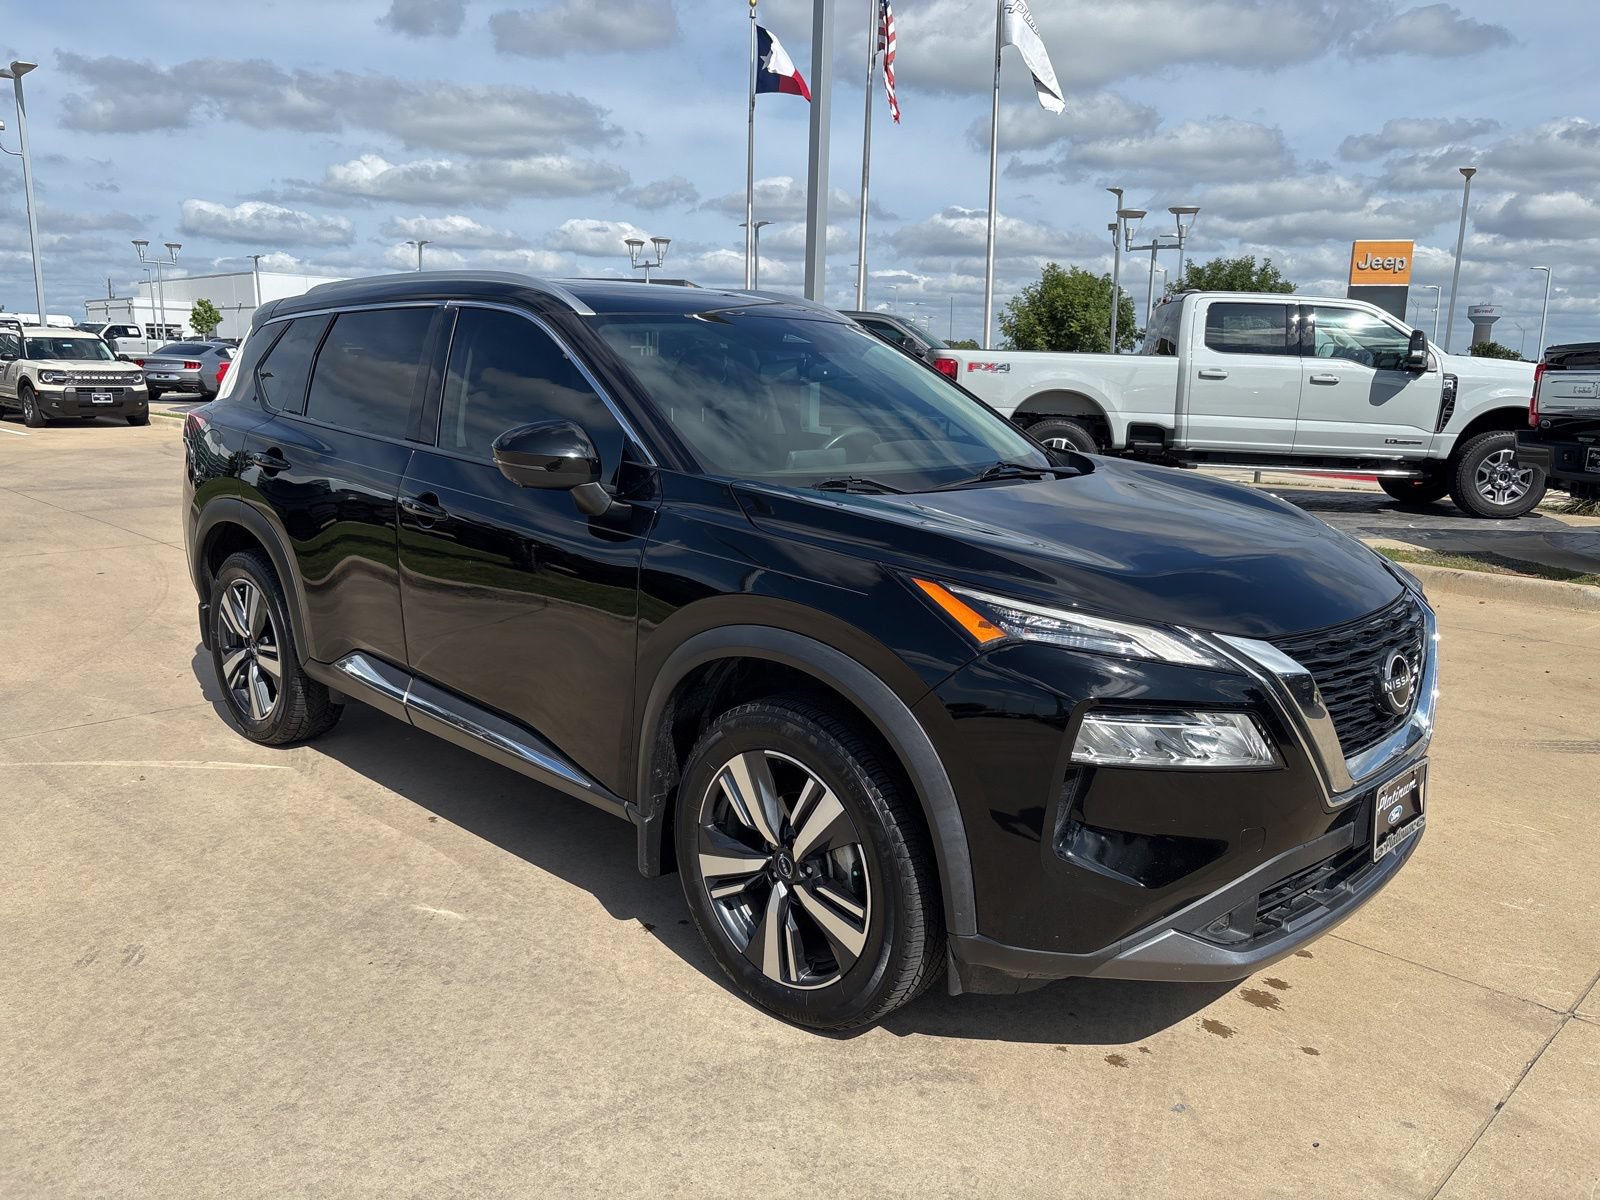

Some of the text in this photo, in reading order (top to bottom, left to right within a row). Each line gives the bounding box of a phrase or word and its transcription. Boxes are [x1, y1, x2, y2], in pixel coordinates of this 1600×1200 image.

[1357, 252, 1407, 274] Jeep
[967, 361, 1011, 372] FX4
[1377, 779, 1418, 815] Platinum
